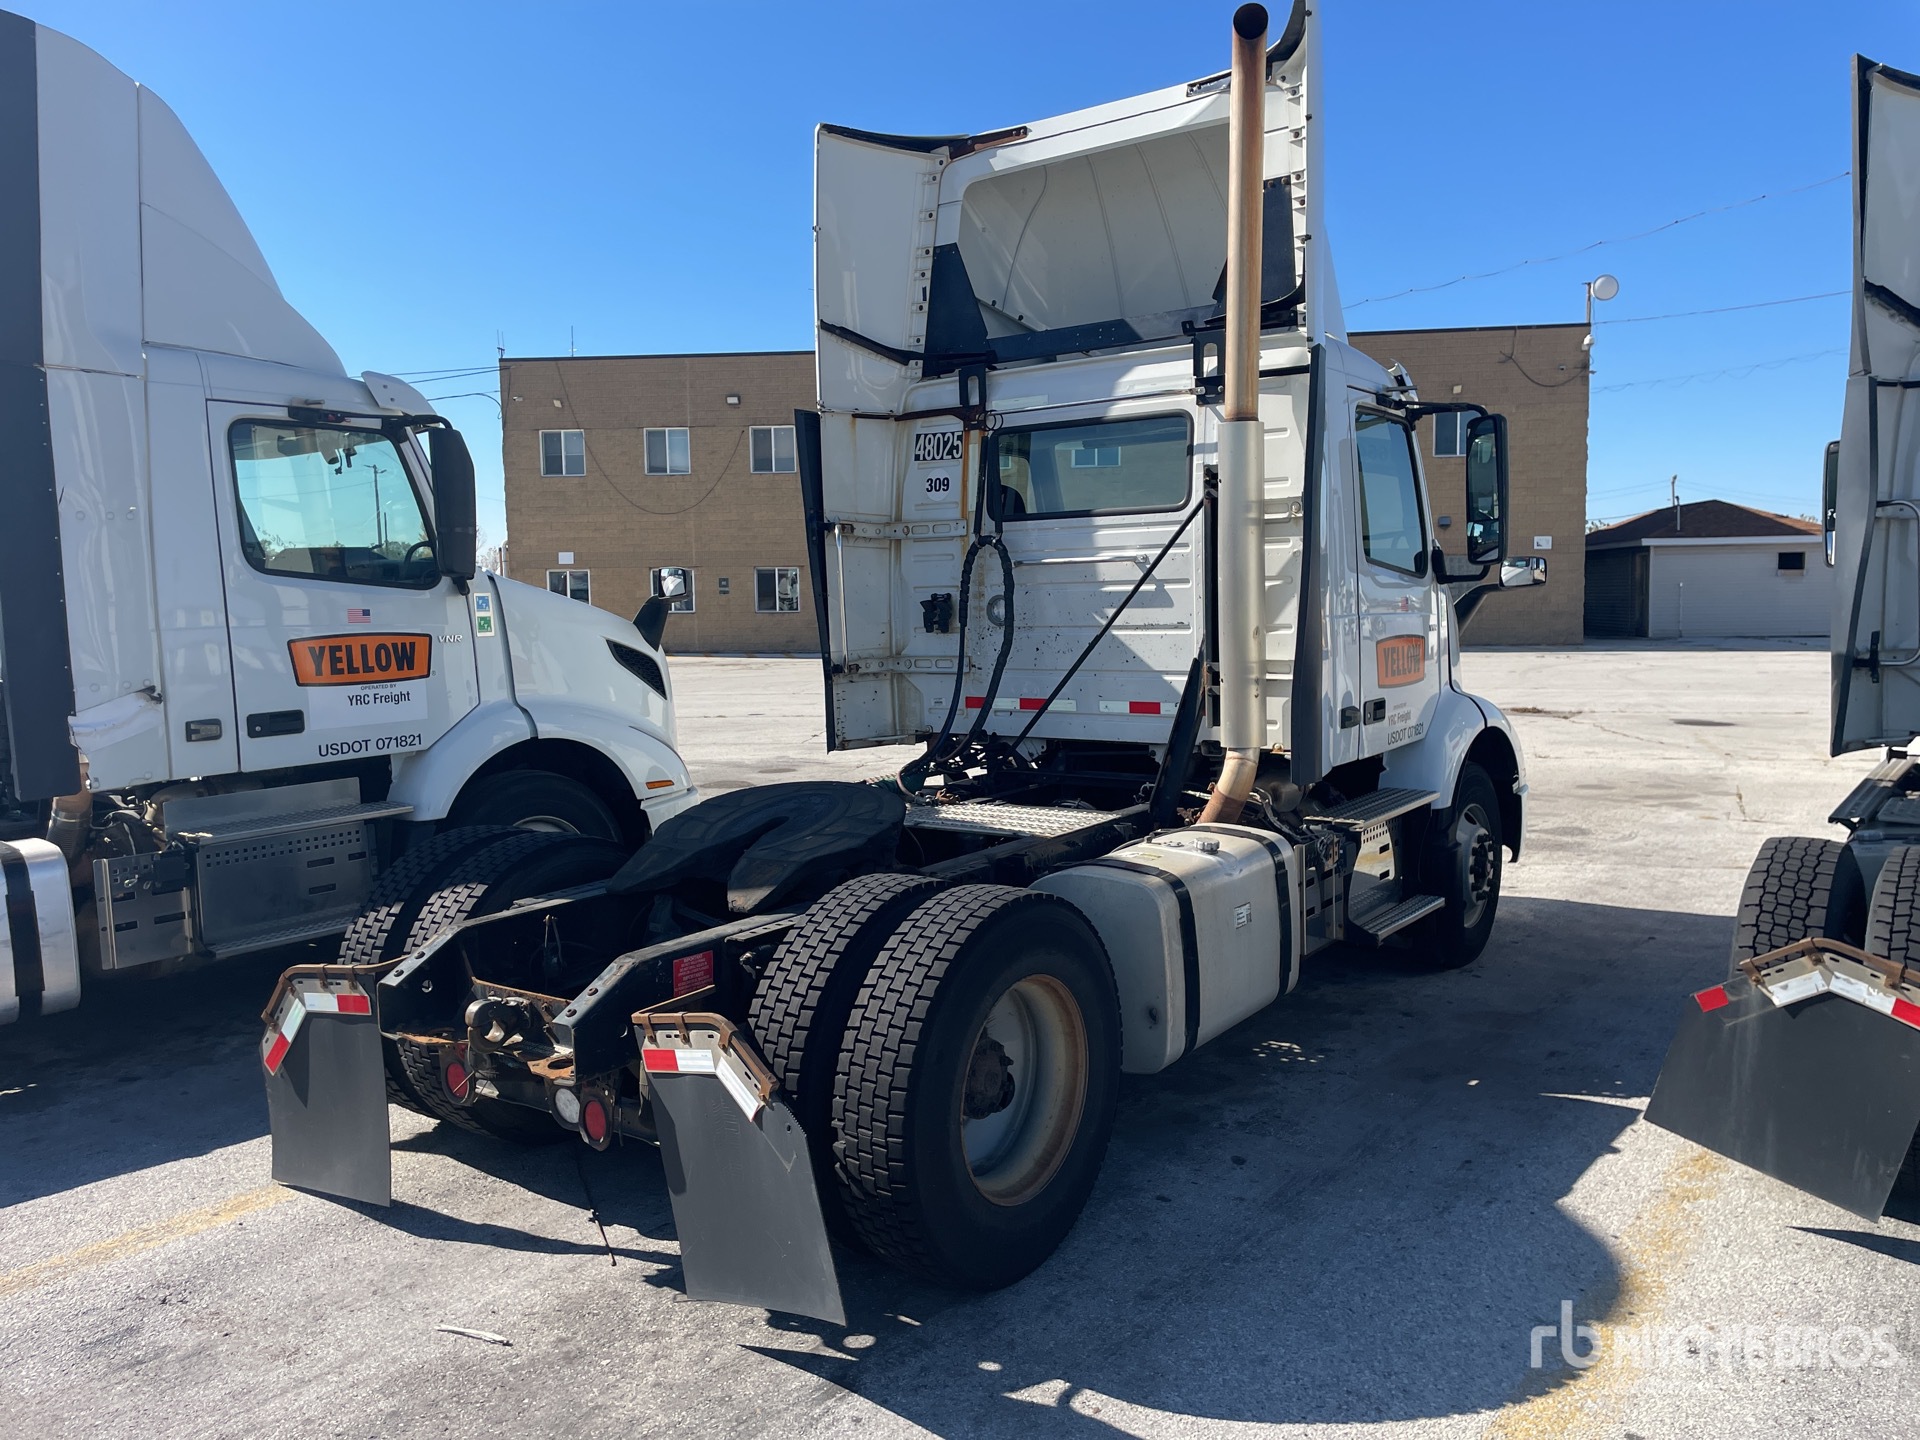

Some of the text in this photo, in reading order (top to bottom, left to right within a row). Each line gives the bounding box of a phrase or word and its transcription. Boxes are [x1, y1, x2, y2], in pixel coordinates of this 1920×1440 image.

[915, 432, 962, 461] 48025
[926, 477, 950, 493] 309
[438, 634, 463, 643] VNR
[307, 641, 416, 677] YELLOW
[1383, 643, 1421, 678] YELLOW
[347, 691, 411, 706] YRC Freight
[318, 733, 422, 757] USDOT 071821
[1387, 728, 1407, 746] USDOT
